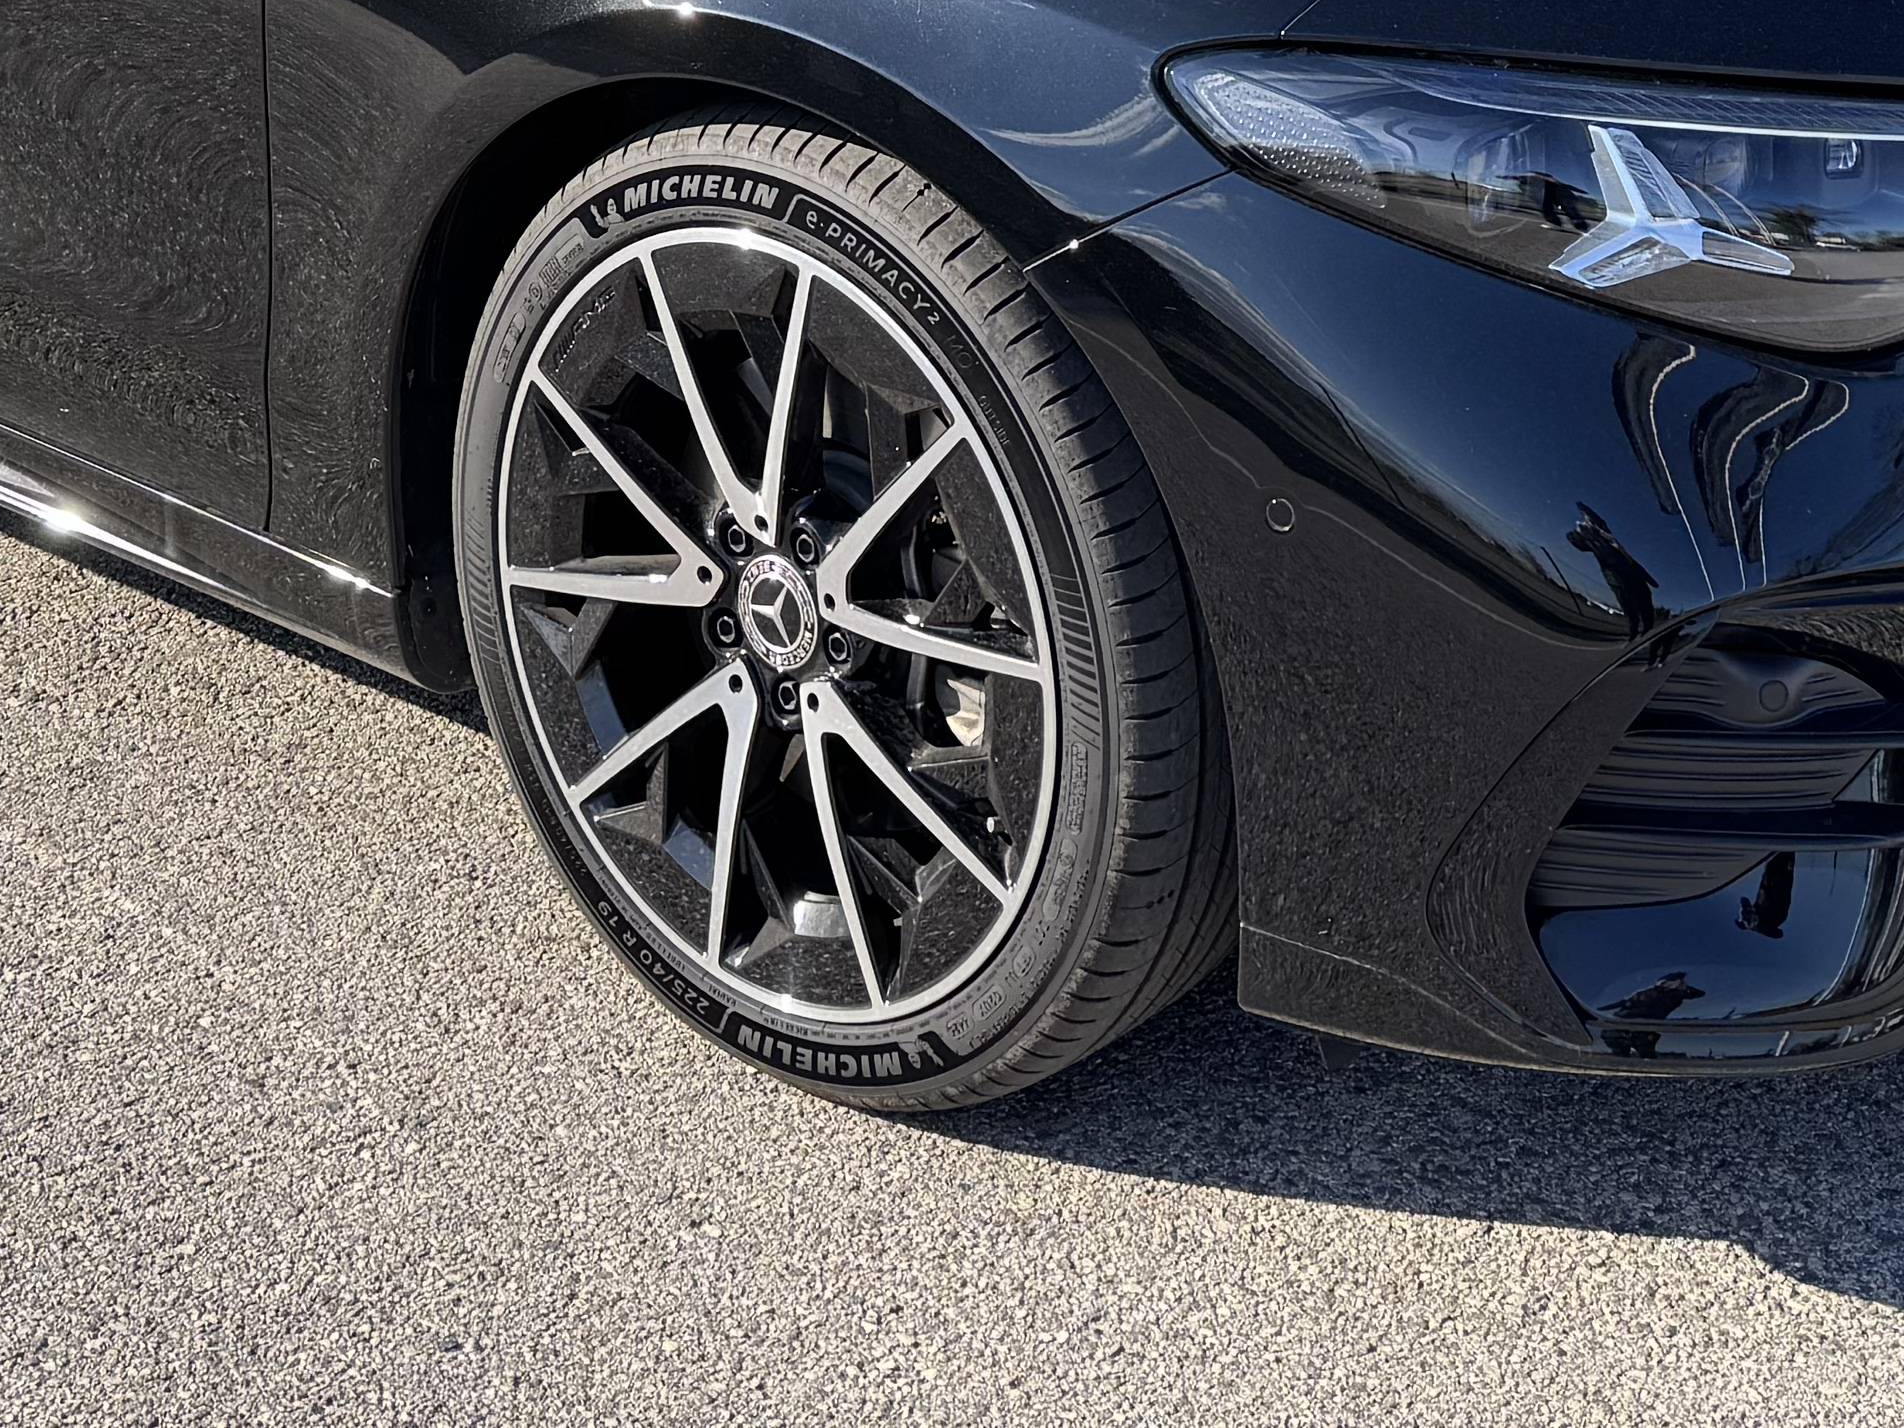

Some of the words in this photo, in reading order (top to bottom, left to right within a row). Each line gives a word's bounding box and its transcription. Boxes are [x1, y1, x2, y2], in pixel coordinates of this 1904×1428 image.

[624, 175, 779, 213] MICHELIN
[598, 901, 618, 927] 19
[622, 931, 637, 947] R
[639, 950, 711, 1015] 225/40
[737, 1024, 903, 1078] MICHELIN
